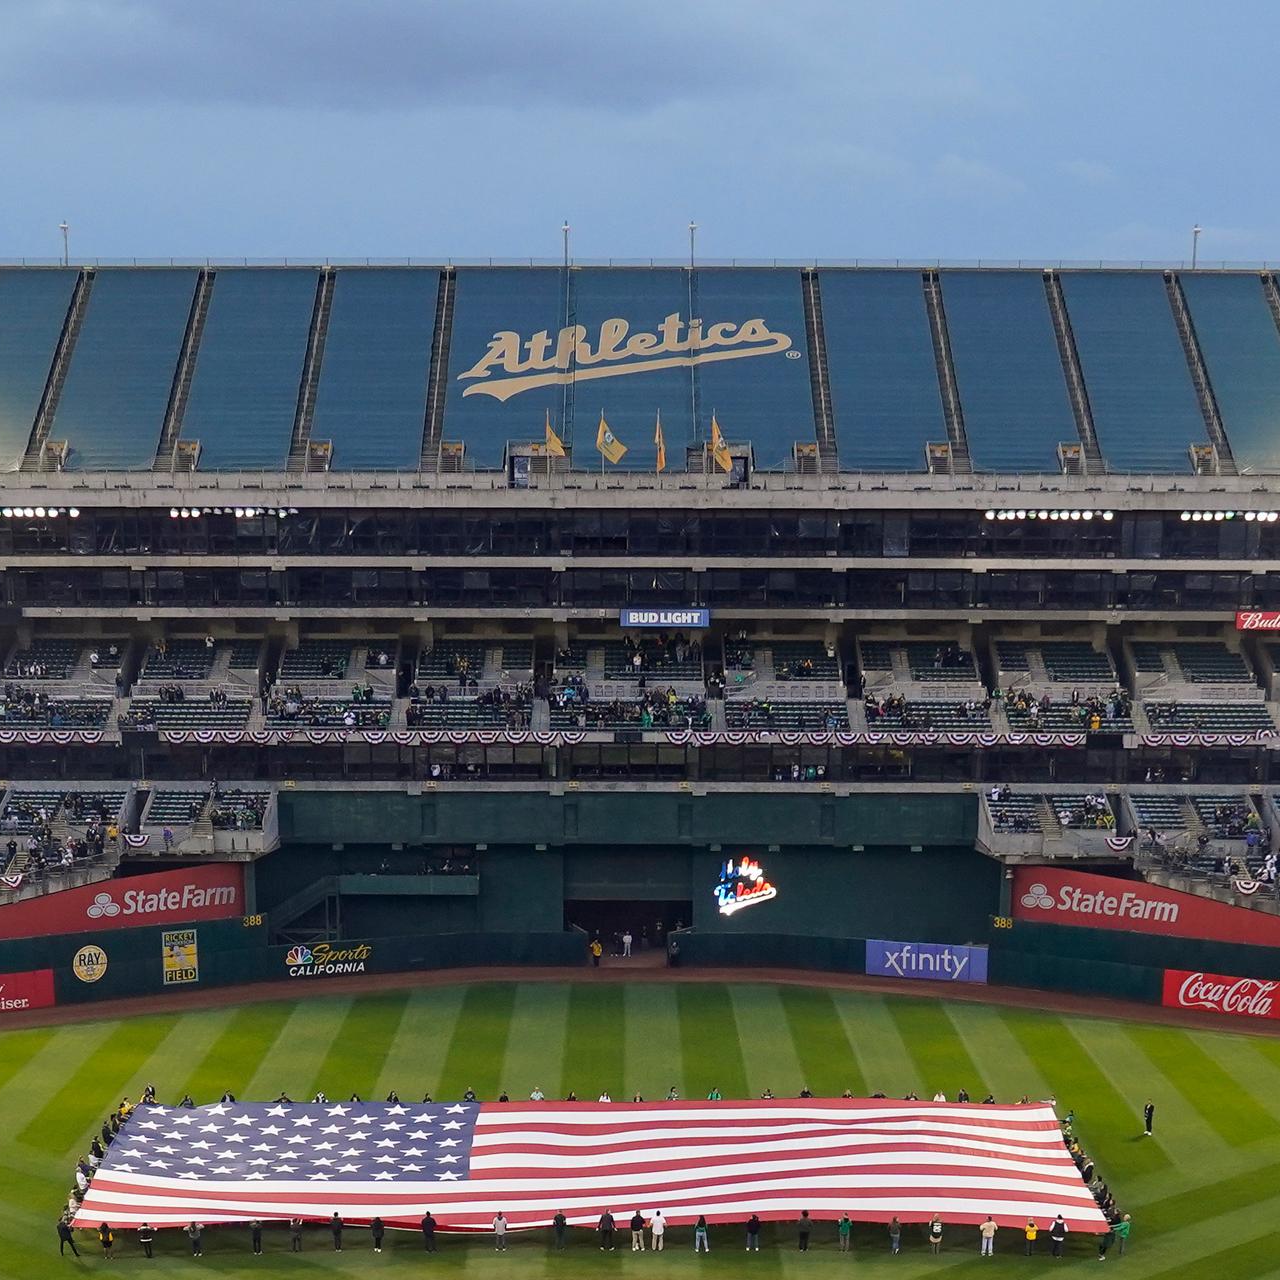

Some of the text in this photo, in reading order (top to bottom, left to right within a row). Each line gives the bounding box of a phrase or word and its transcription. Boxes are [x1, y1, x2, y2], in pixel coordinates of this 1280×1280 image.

[457, 312, 789, 388] Athletics
[629, 612, 700, 624] BUD LIGHT
[719, 856, 763, 881] Holy
[714, 877, 772, 906] Toledo
[243, 915, 262, 927] 388
[993, 917, 1013, 929] 388
[166, 932, 193, 942] RICKEY
[79, 952, 101, 966] RAY
[312, 944, 371, 966] Sports
[884, 945, 969, 979] xfinity
[167, 969, 195, 981] FIELD
[289, 962, 365, 977] CALIFORNIA
[1178, 972, 1280, 1015] Coca-Cola
